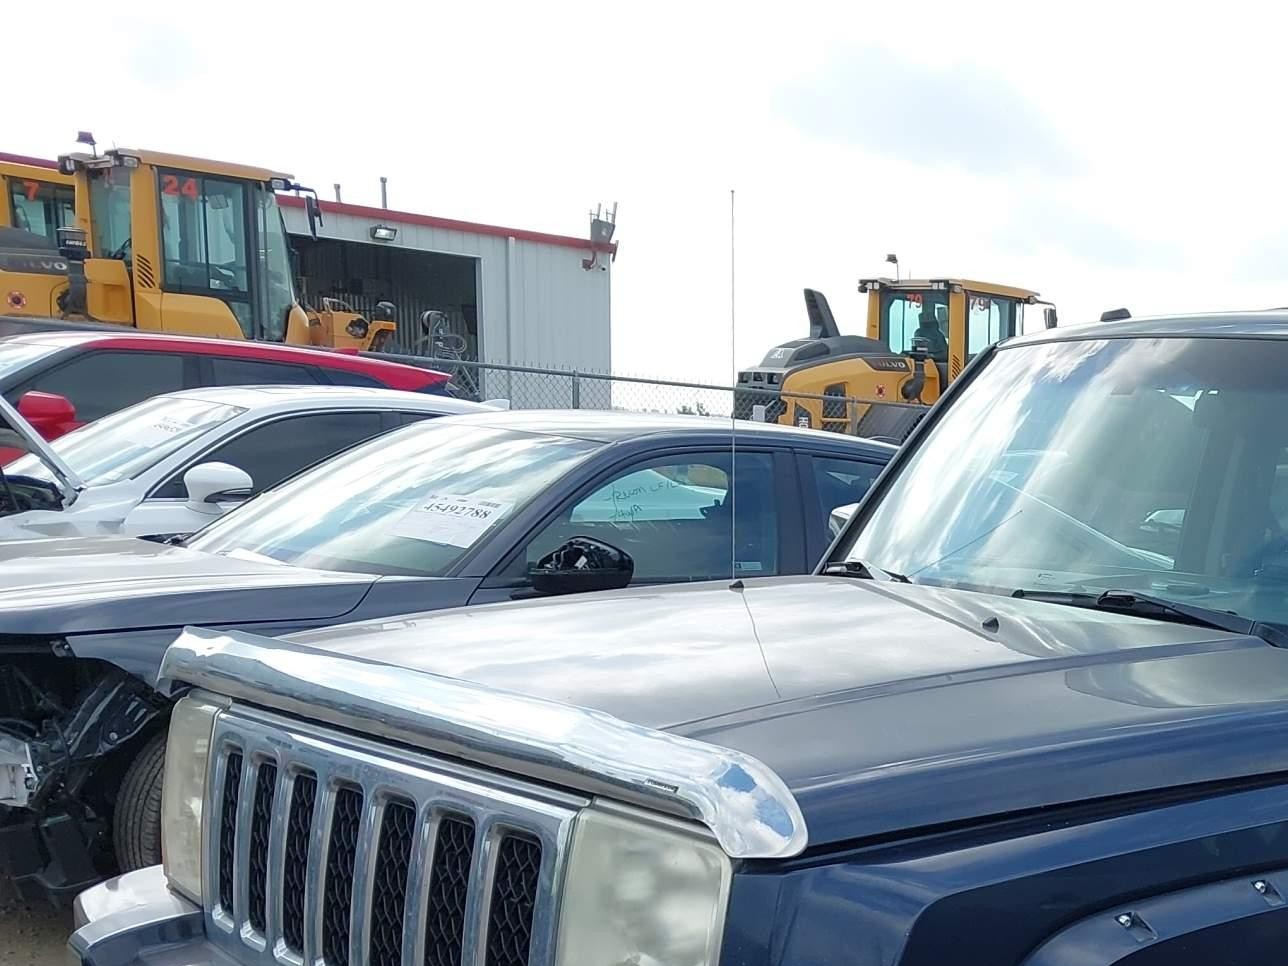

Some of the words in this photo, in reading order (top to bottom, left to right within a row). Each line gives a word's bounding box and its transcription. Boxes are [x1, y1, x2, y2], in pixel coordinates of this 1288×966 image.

[24, 180, 39, 202] 7
[163, 174, 198, 200] 24
[905, 293, 923, 309] 79
[970, 296, 987, 311] 79
[423, 501, 493, 519] 45492788
